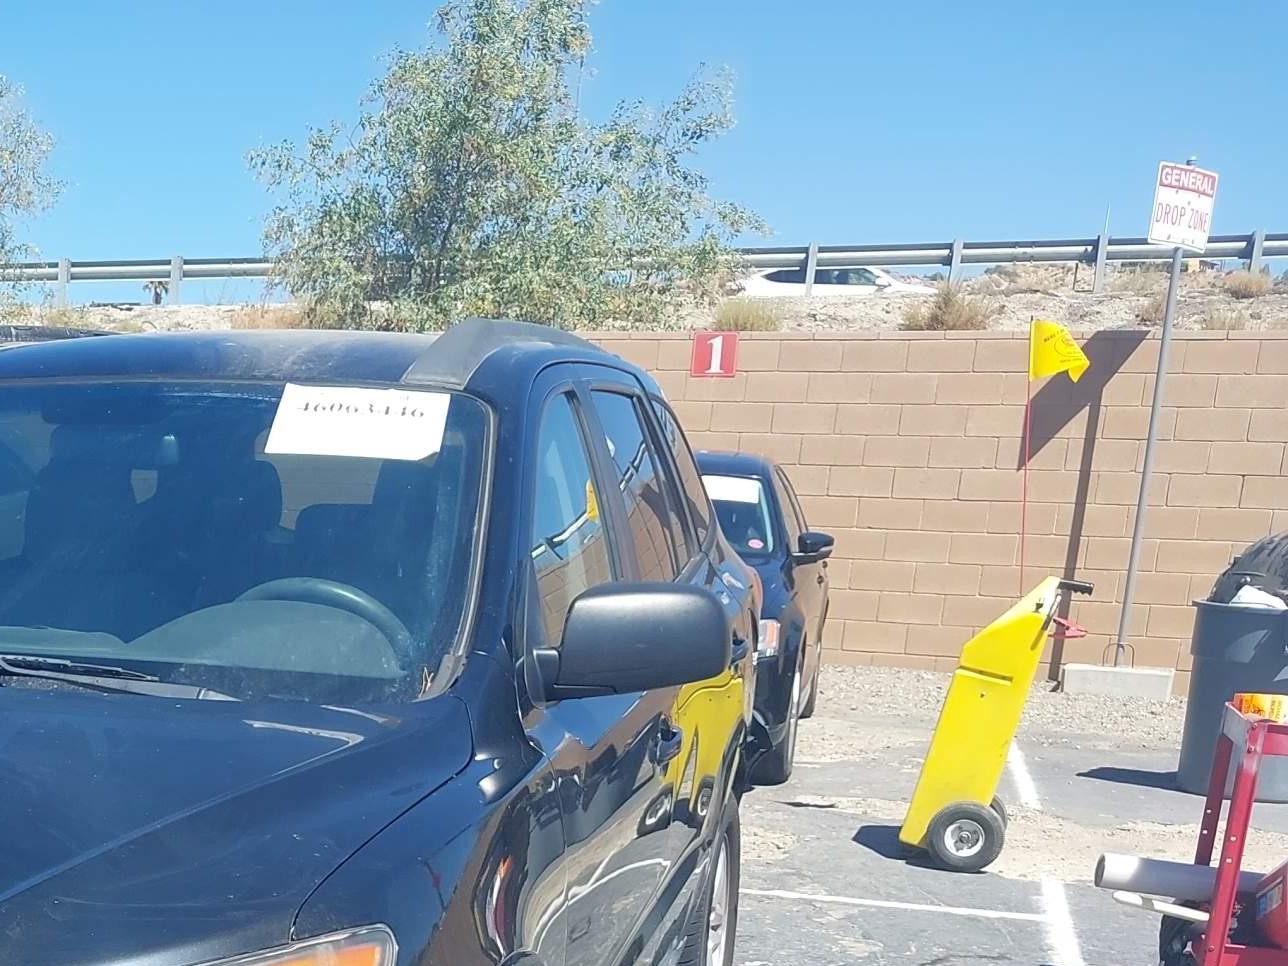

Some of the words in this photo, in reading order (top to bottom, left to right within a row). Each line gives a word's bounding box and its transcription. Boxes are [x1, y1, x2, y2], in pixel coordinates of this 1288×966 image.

[1161, 166, 1214, 195] GENERAL
[1155, 201, 1187, 226] DROP
[1187, 208, 1210, 234] ZONE
[704, 335, 725, 374] 1
